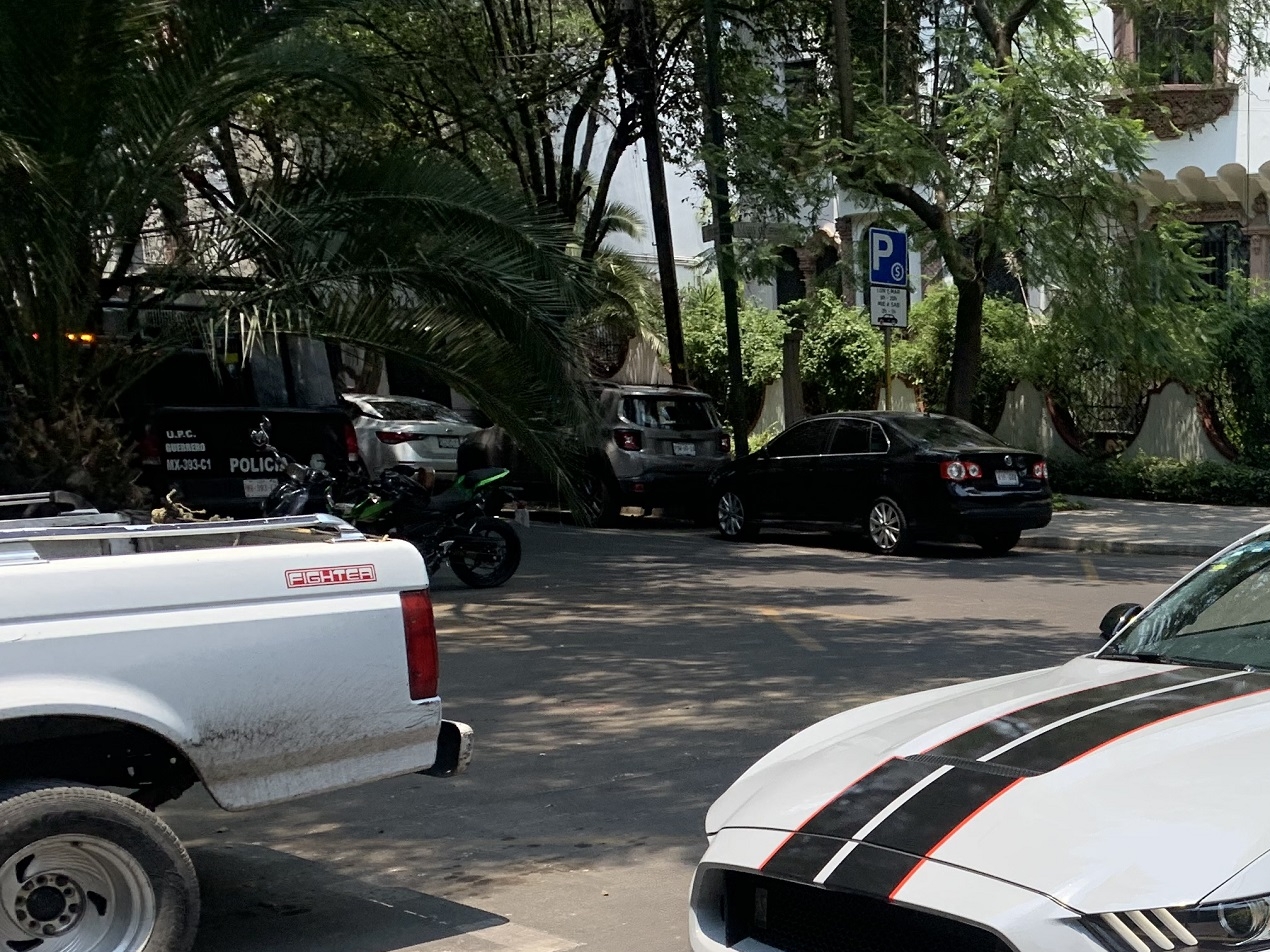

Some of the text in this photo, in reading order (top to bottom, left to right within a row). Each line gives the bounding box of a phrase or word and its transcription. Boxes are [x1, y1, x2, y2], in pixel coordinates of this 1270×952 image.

[872, 232, 894, 271] P
[166, 430, 196, 439] U.P.C.
[165, 442, 206, 453] GUERRERO
[288, 566, 374, 586] FIGHTER
